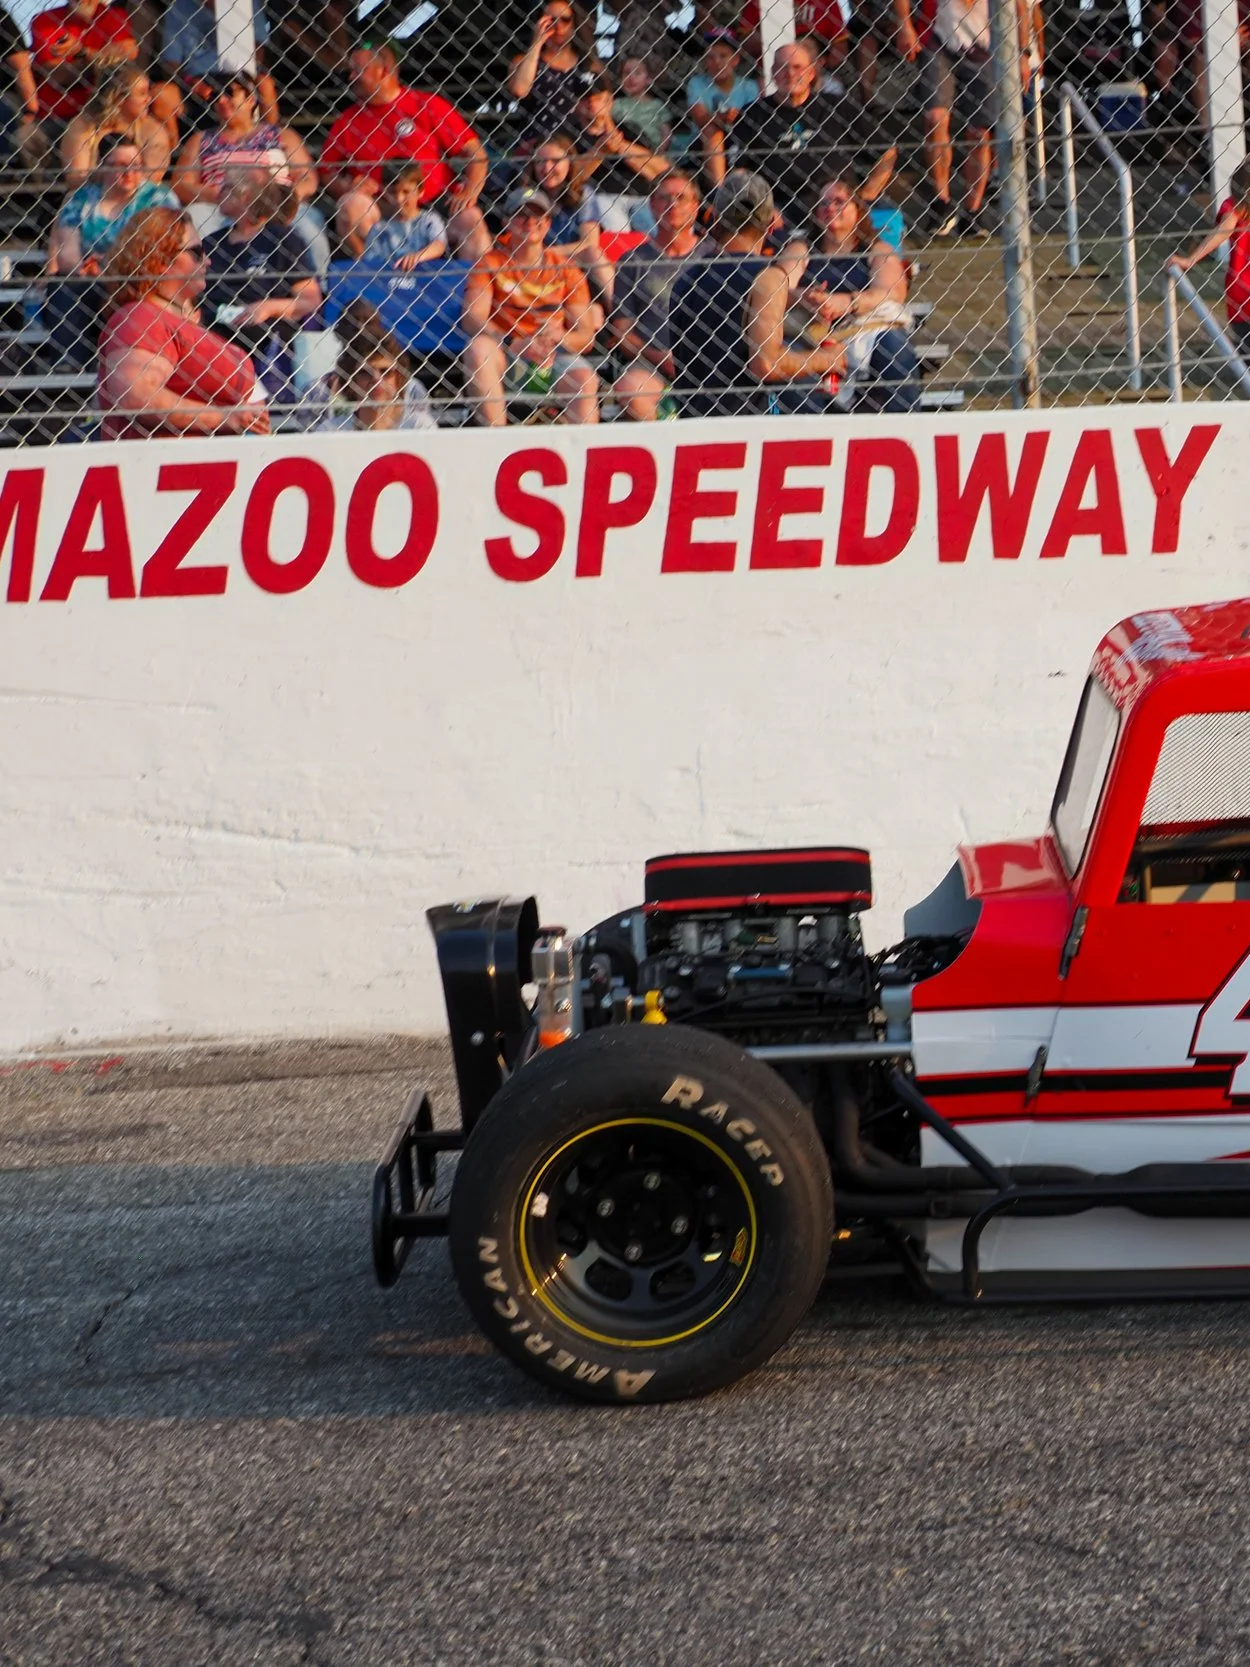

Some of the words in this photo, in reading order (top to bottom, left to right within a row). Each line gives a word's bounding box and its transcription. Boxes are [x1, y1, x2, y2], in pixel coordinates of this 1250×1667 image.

[484, 423, 1222, 583] SPEEDWAY
[478, 1236, 656, 1397] AMERICAN
[660, 1074, 784, 1187] RACER
